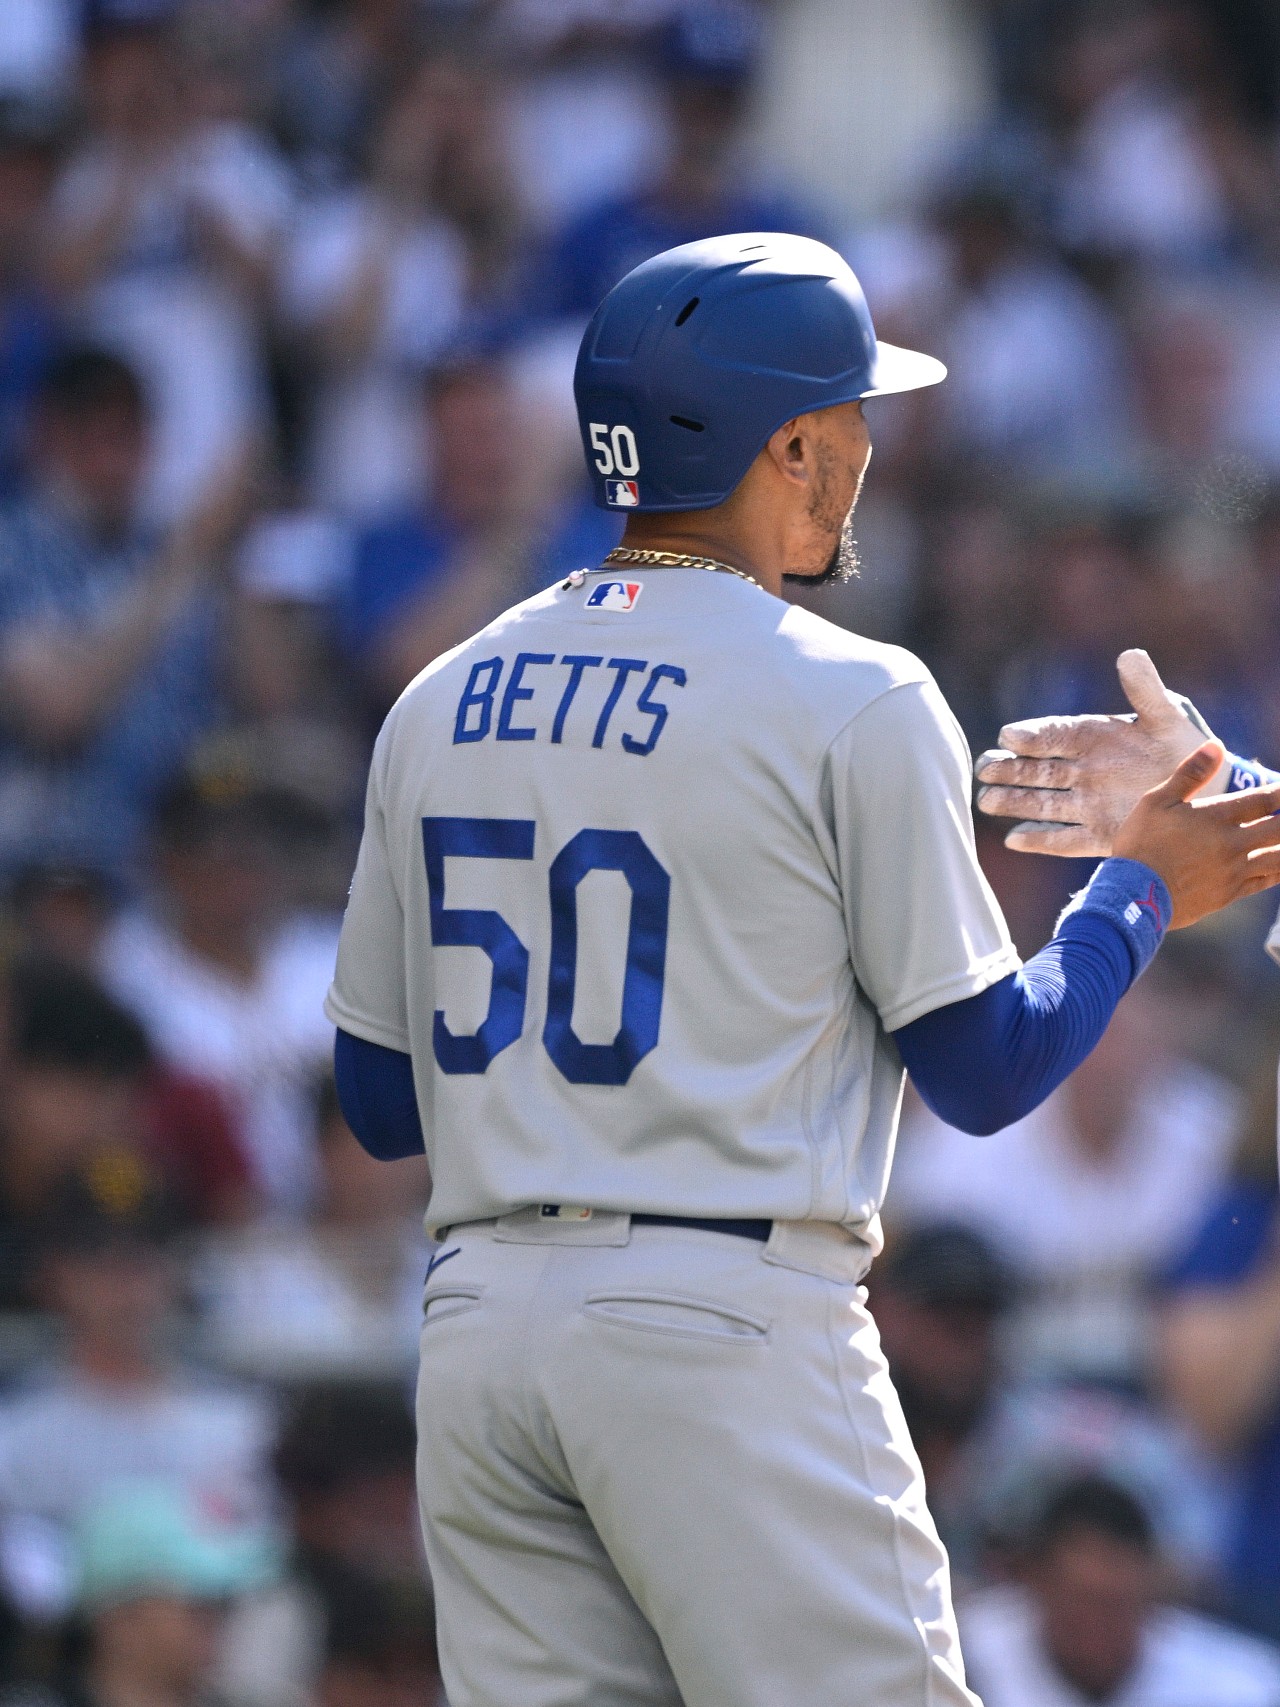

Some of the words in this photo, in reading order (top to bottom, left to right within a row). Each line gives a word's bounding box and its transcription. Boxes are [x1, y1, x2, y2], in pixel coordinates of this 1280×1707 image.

[589, 422, 640, 477] 50
[453, 652, 687, 757] BETTS
[421, 816, 672, 1087] 50
